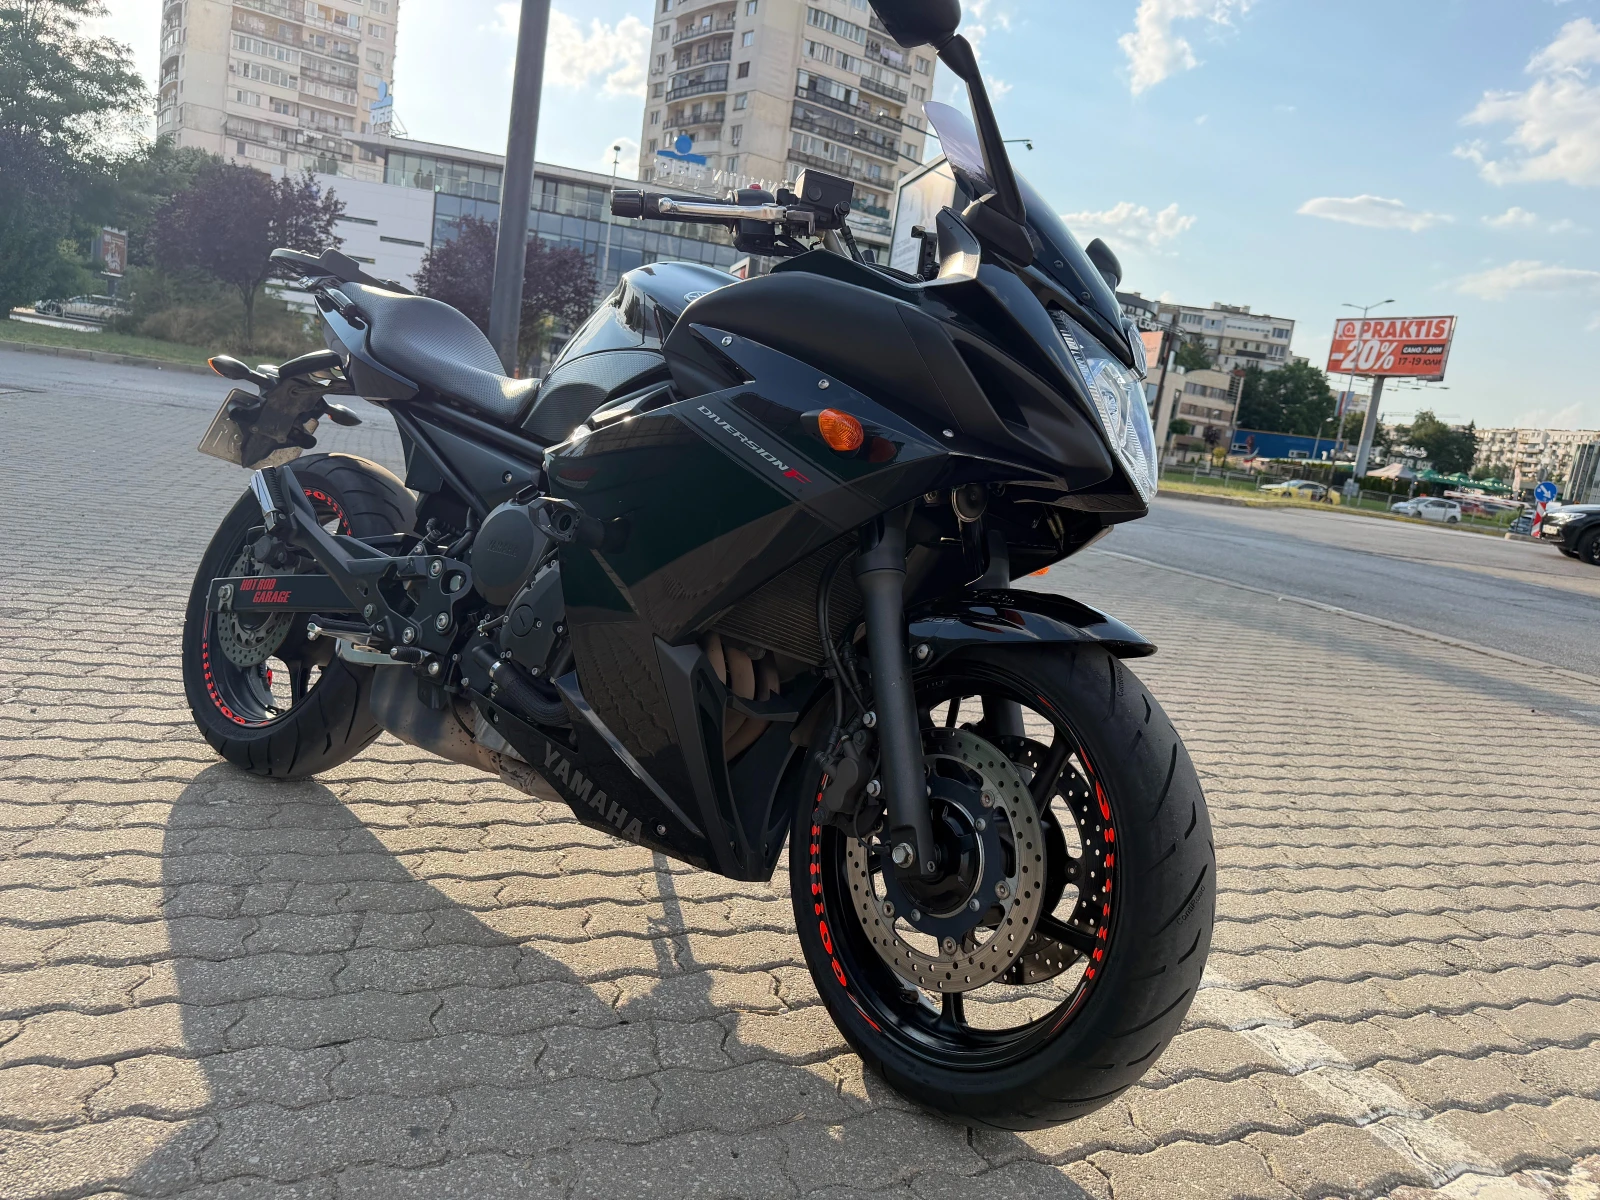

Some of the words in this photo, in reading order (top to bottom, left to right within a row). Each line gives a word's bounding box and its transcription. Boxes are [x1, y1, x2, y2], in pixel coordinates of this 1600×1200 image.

[1361, 319, 1446, 338] PRAKTIS
[1331, 340, 1398, 370] -20%
[697, 405, 789, 471] DIVERSION
[240, 578, 258, 591] HOT
[256, 578, 277, 590] ROD
[253, 591, 291, 603] GARAGE
[543, 741, 643, 842] YAMAHA
[1176, 884, 1206, 926] ContiRoad
